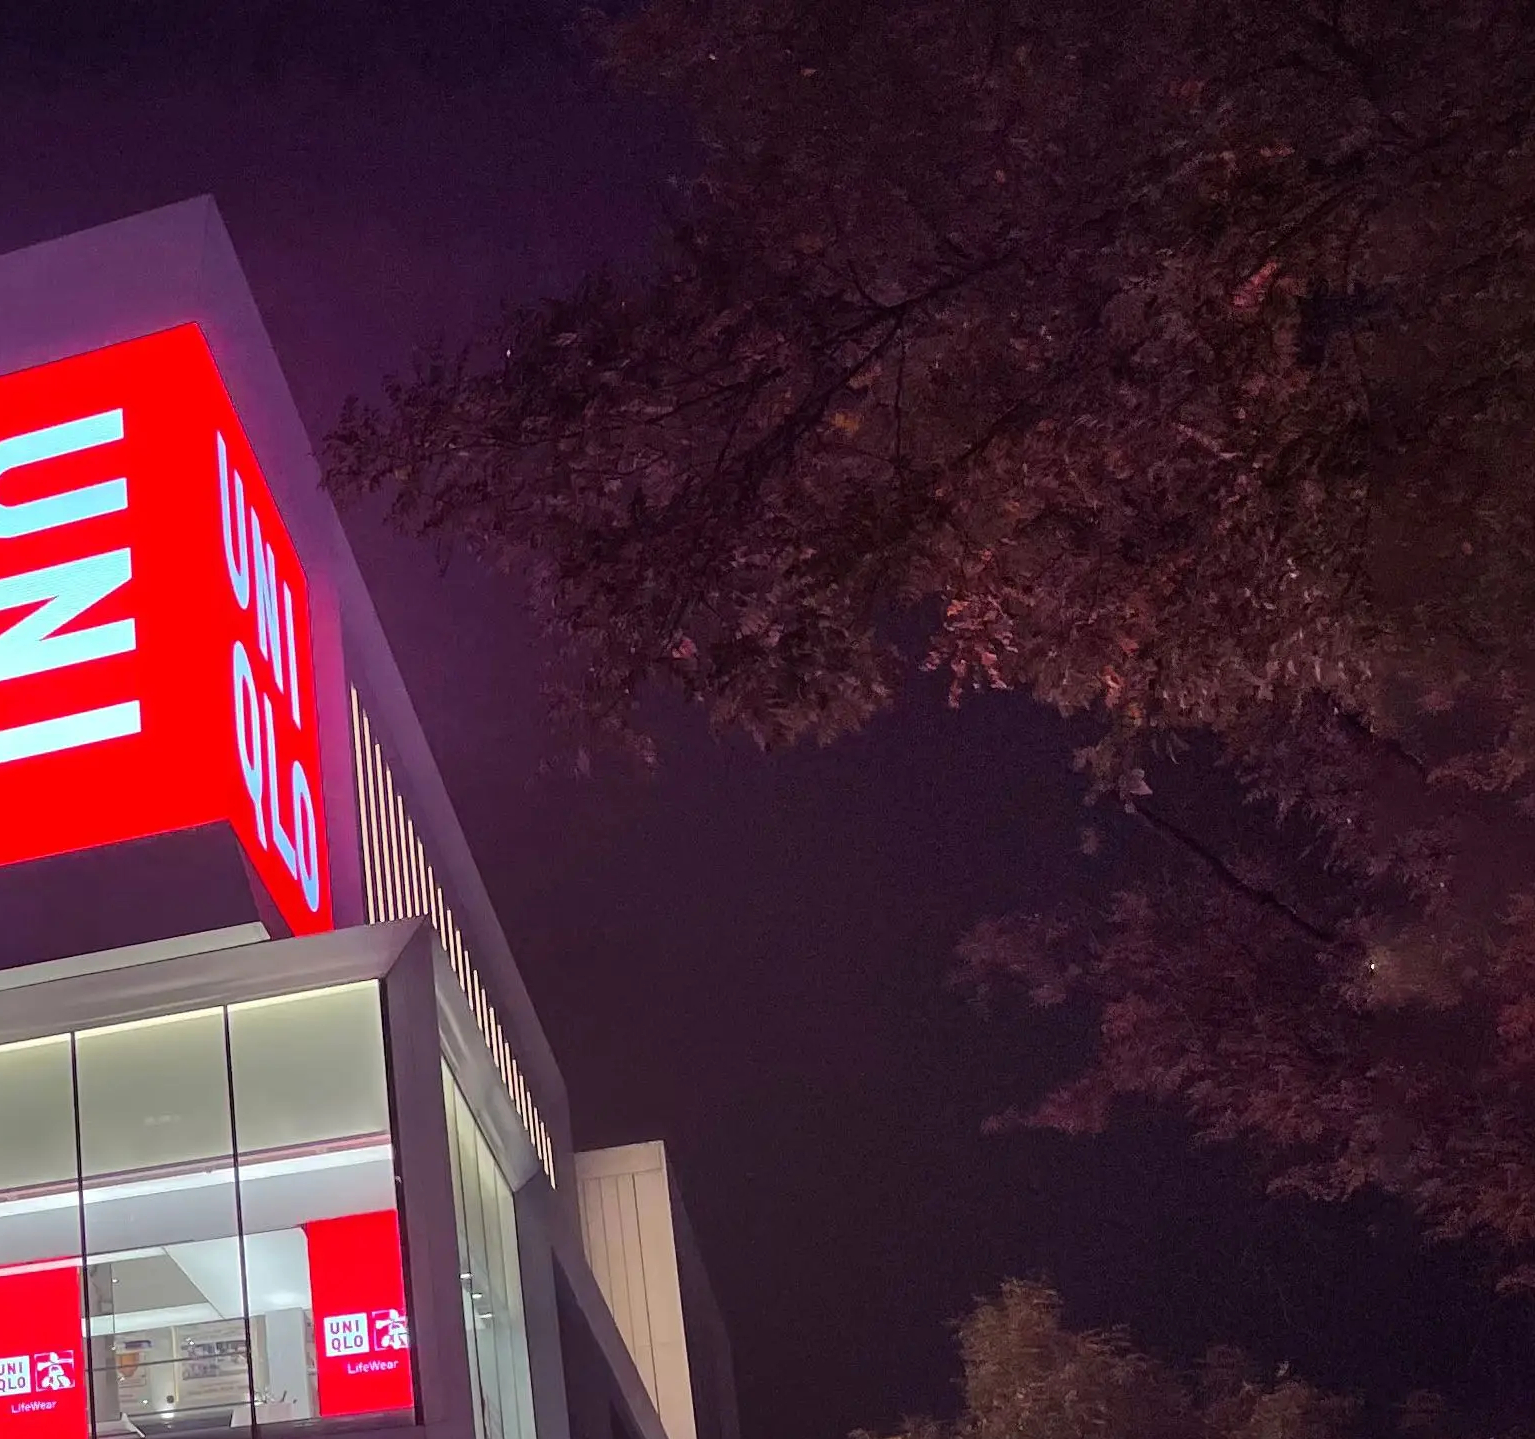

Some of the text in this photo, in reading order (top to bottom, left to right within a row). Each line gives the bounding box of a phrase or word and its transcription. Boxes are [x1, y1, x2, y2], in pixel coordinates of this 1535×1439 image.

[216, 430, 301, 732] UNI
[233, 640, 320, 913] QLO
[329, 1319, 360, 1335] UNI
[331, 1335, 364, 1353] QLO
[347, 1360, 400, 1375] LifeWear
[10, 1400, 58, 1414] LifeWear
